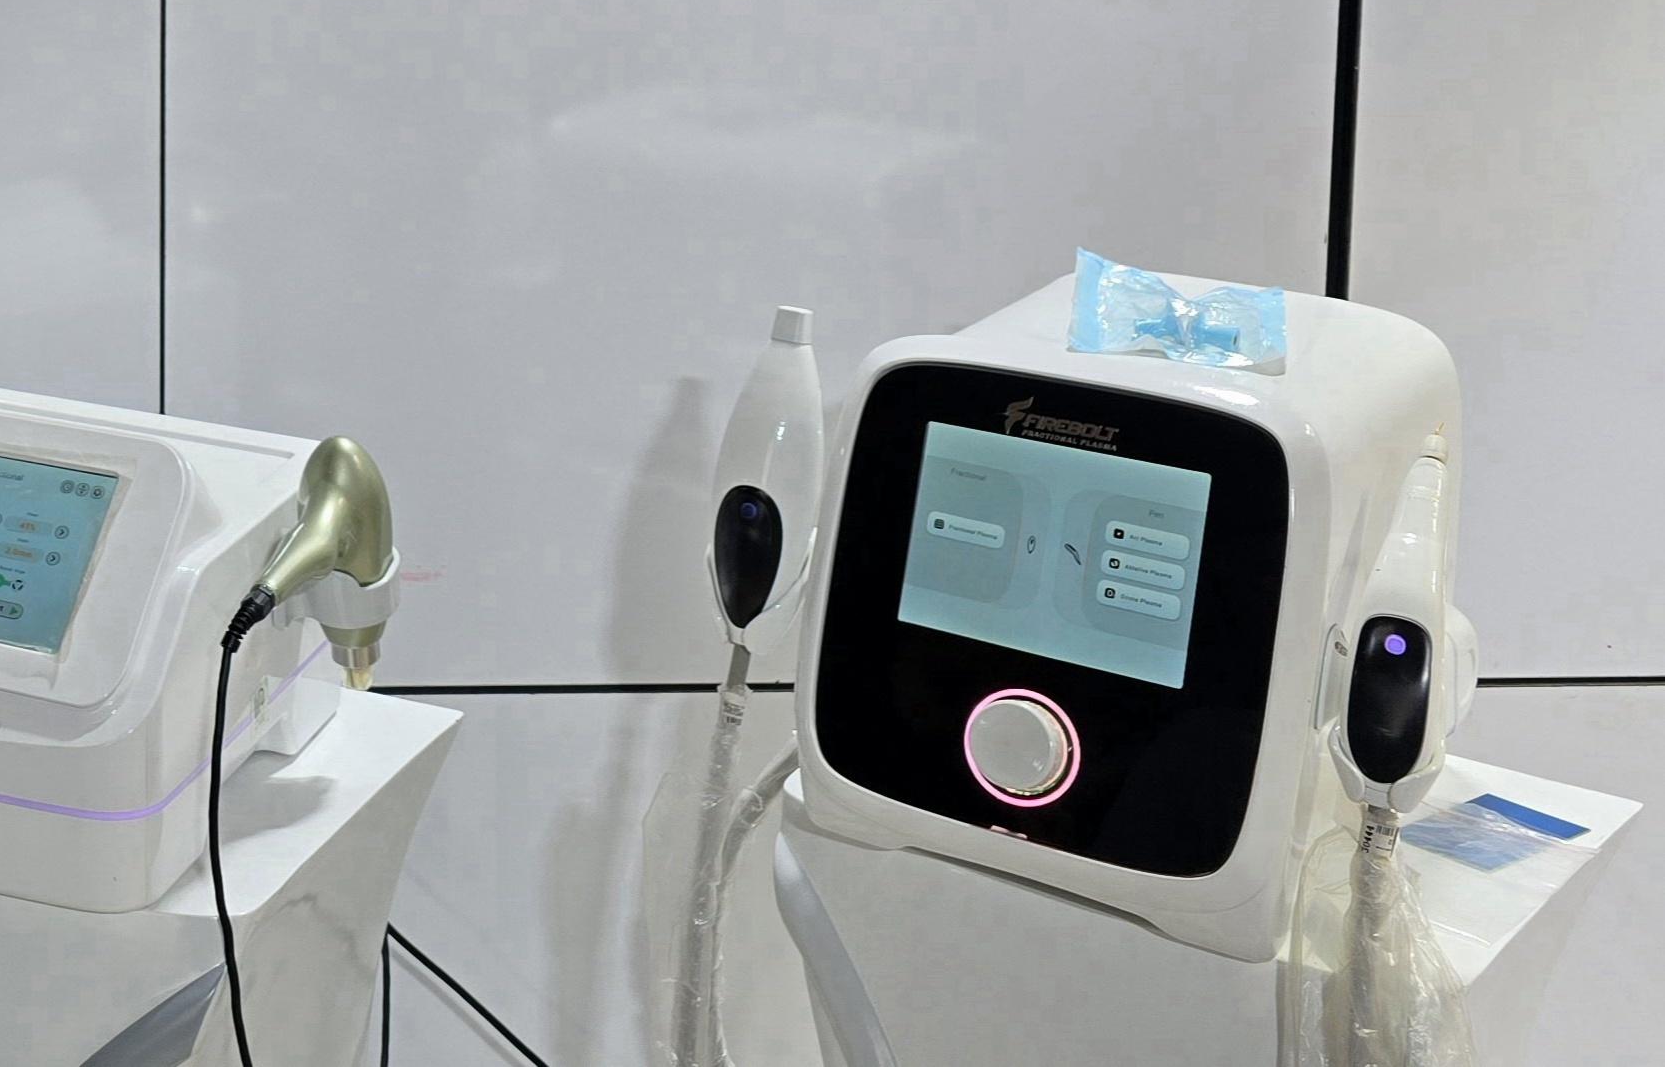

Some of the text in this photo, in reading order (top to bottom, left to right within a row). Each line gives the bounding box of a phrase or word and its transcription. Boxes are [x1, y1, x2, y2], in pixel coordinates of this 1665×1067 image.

[1021, 429, 1118, 452] FRACTIONAL PLASMA
[1022, 414, 1120, 442] FIREBOLT
